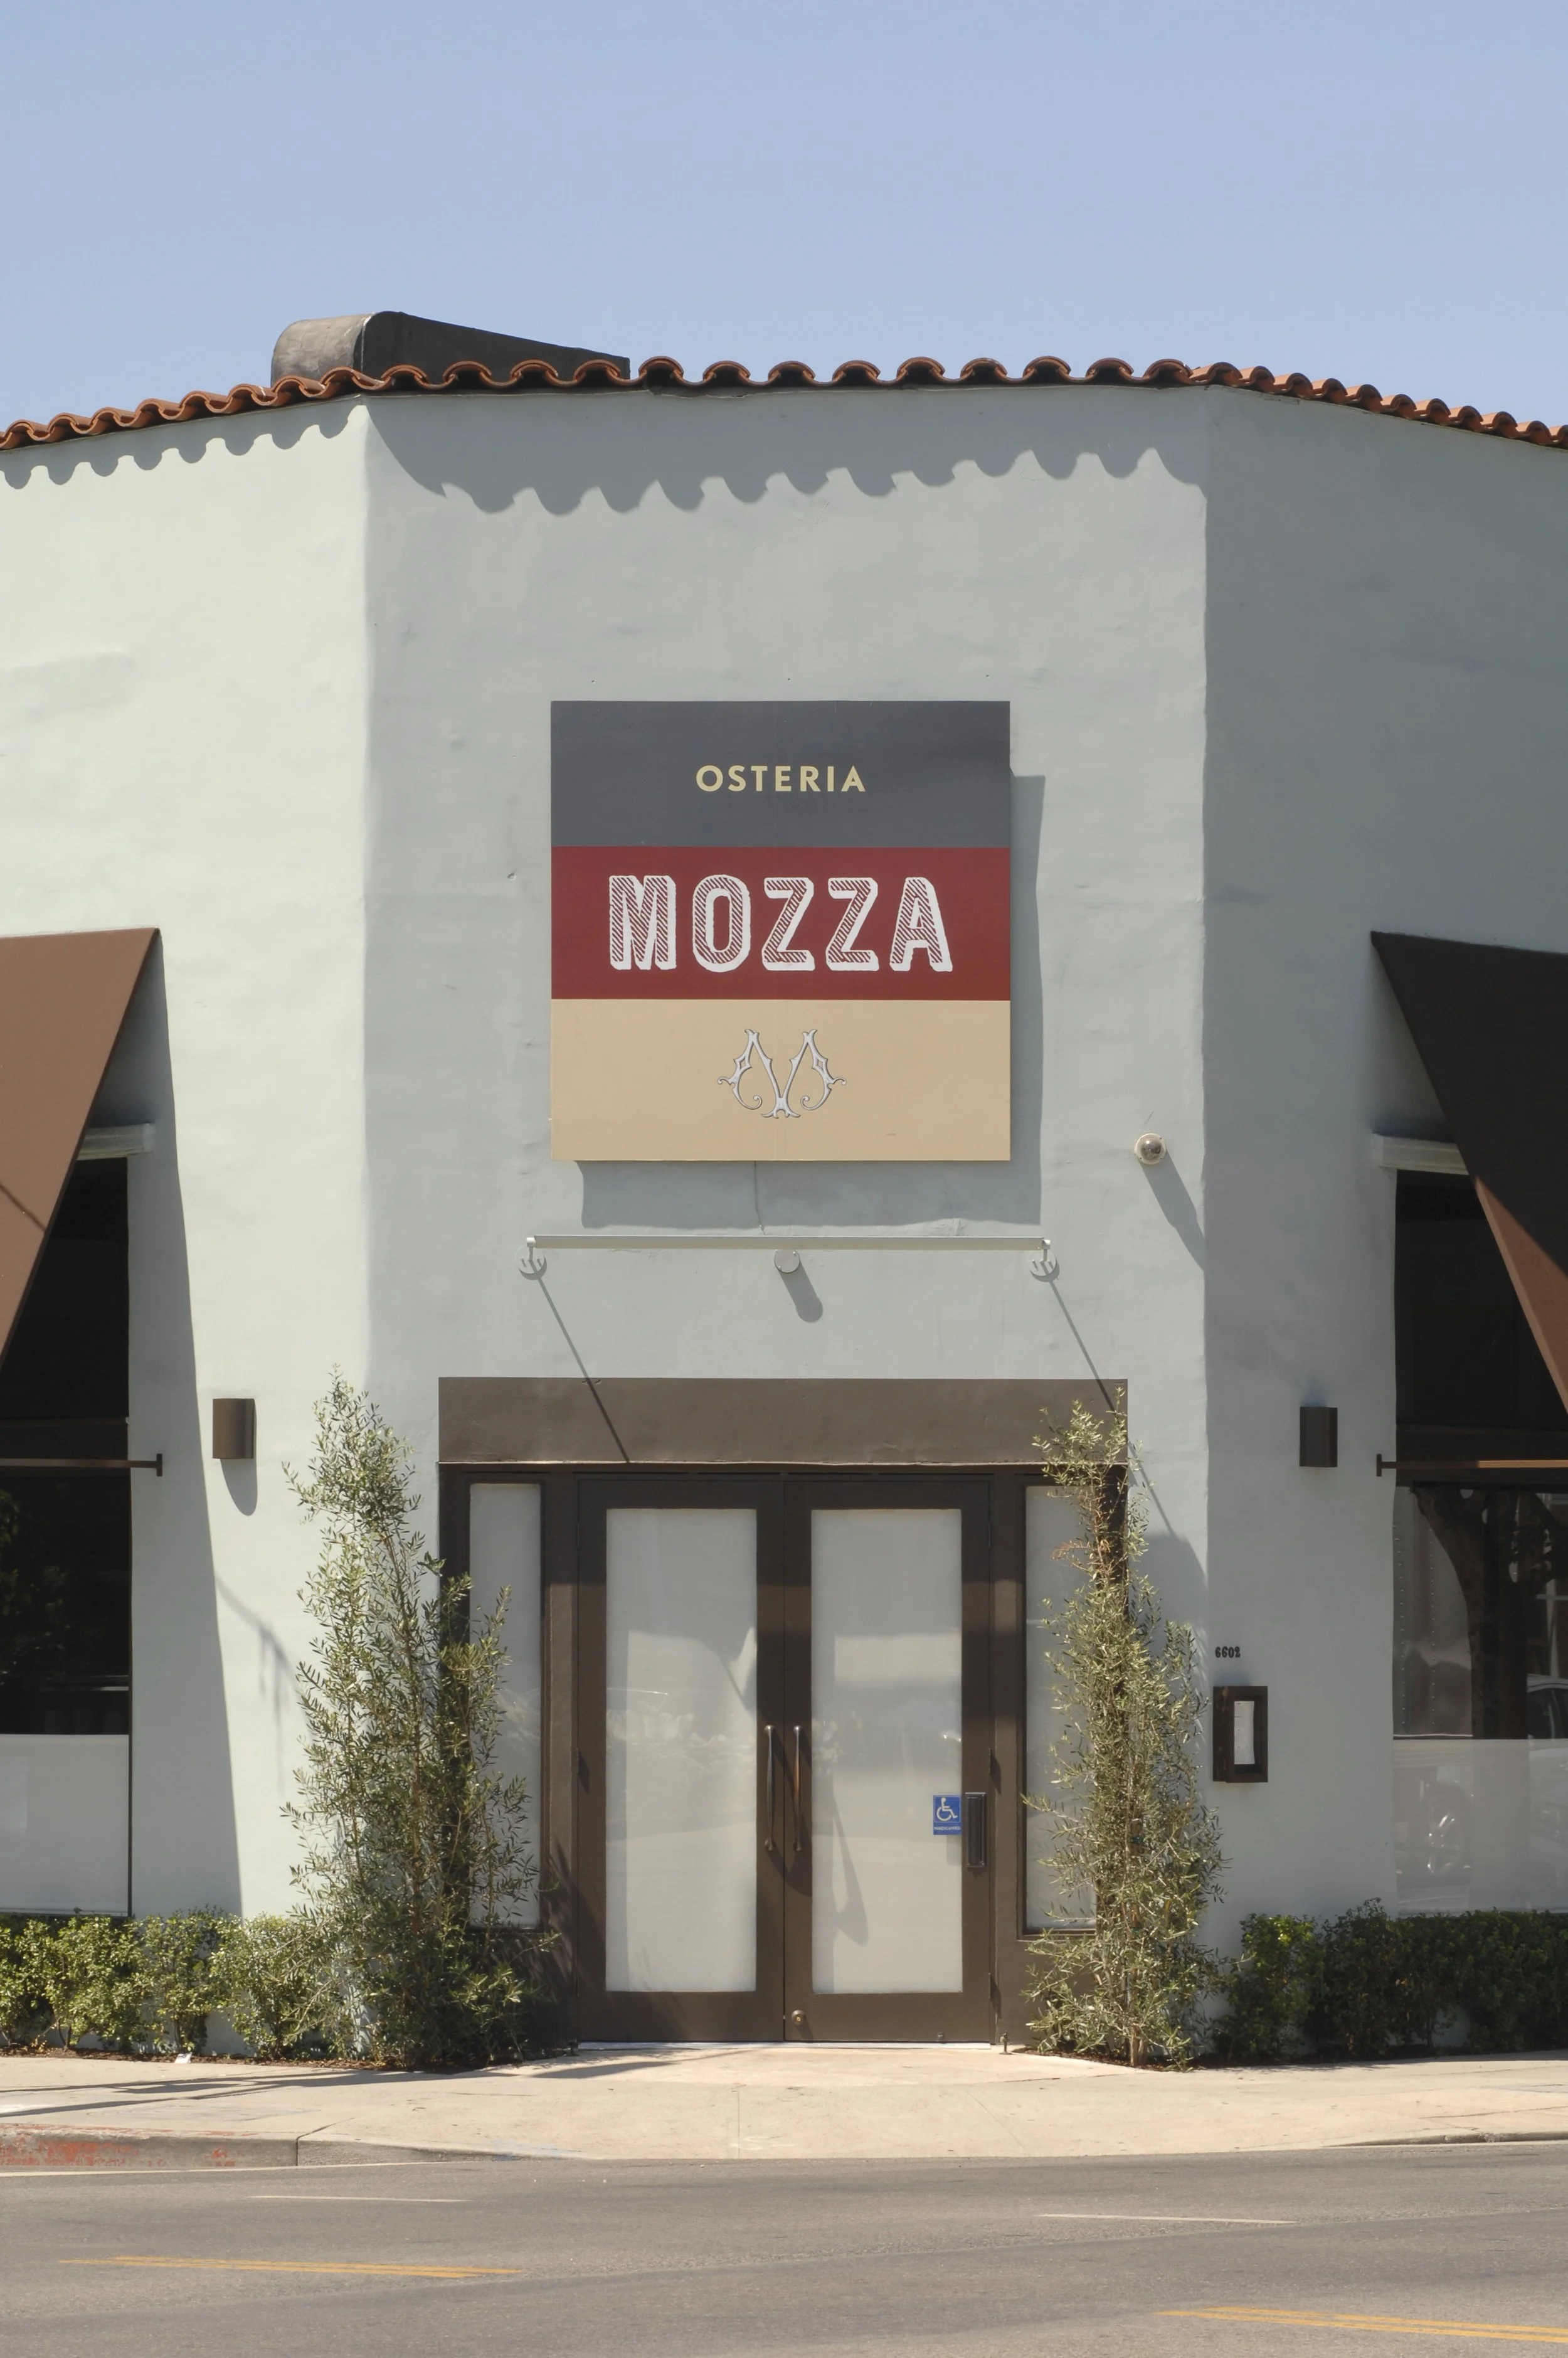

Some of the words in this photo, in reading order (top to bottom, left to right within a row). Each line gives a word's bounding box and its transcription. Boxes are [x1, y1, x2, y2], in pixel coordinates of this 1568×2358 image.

[696, 765, 866, 792] OSTERIA
[609, 874, 953, 972] MOZZA
[1215, 1646, 1241, 1658] 6602
